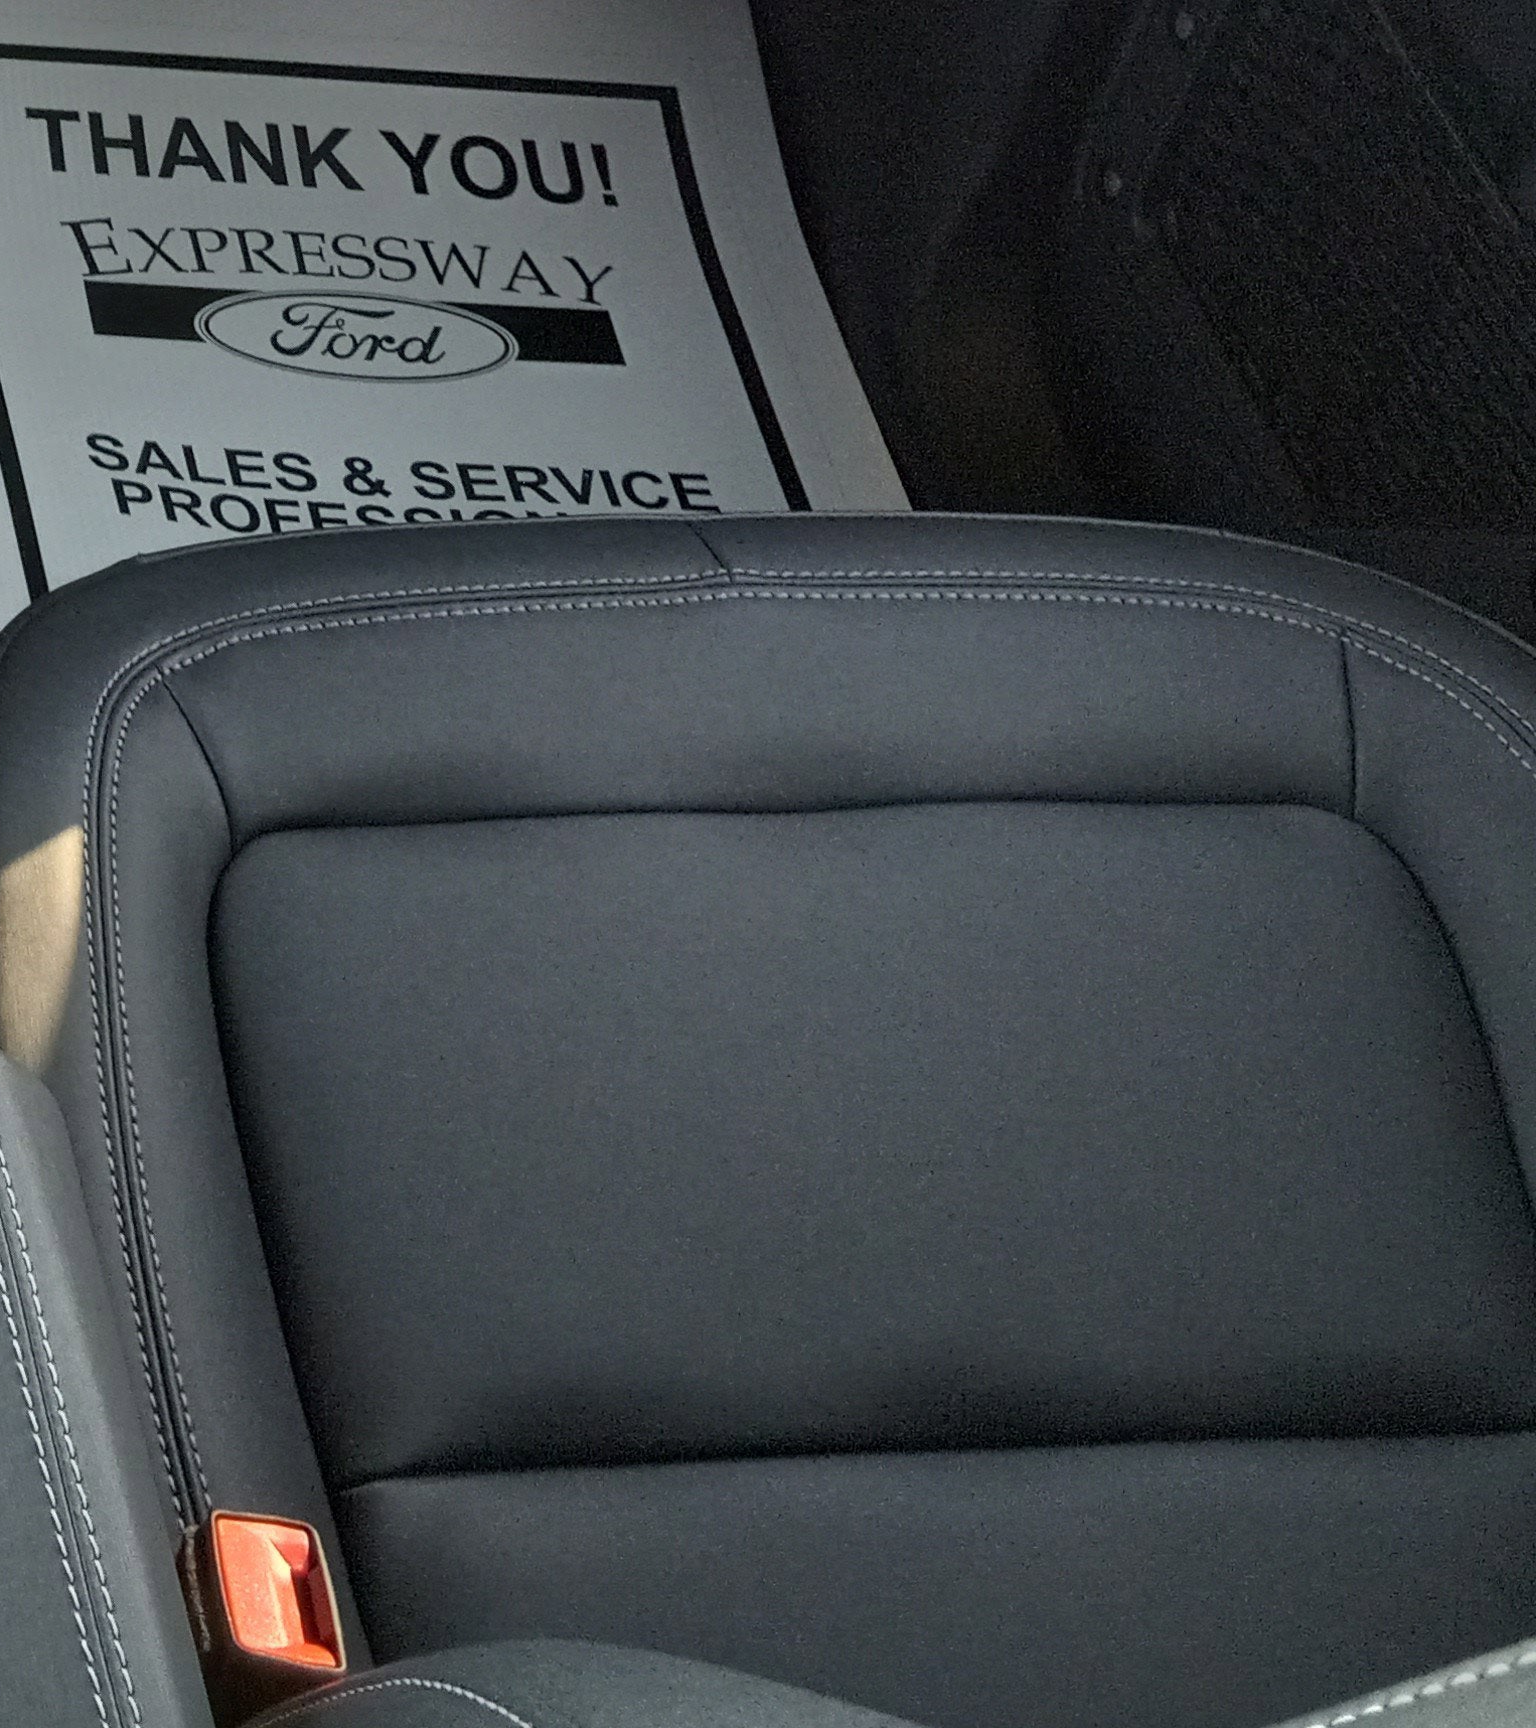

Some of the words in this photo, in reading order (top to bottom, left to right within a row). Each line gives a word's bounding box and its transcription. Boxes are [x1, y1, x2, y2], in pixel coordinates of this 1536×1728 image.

[25, 107, 365, 192] THANK
[381, 130, 619, 208] YOU!
[60, 216, 614, 307] EXPRESSWAY
[270, 302, 445, 365] Ford
[86, 433, 317, 493] SALES
[344, 456, 391, 498] &
[411, 459, 722, 515] SERVICE
